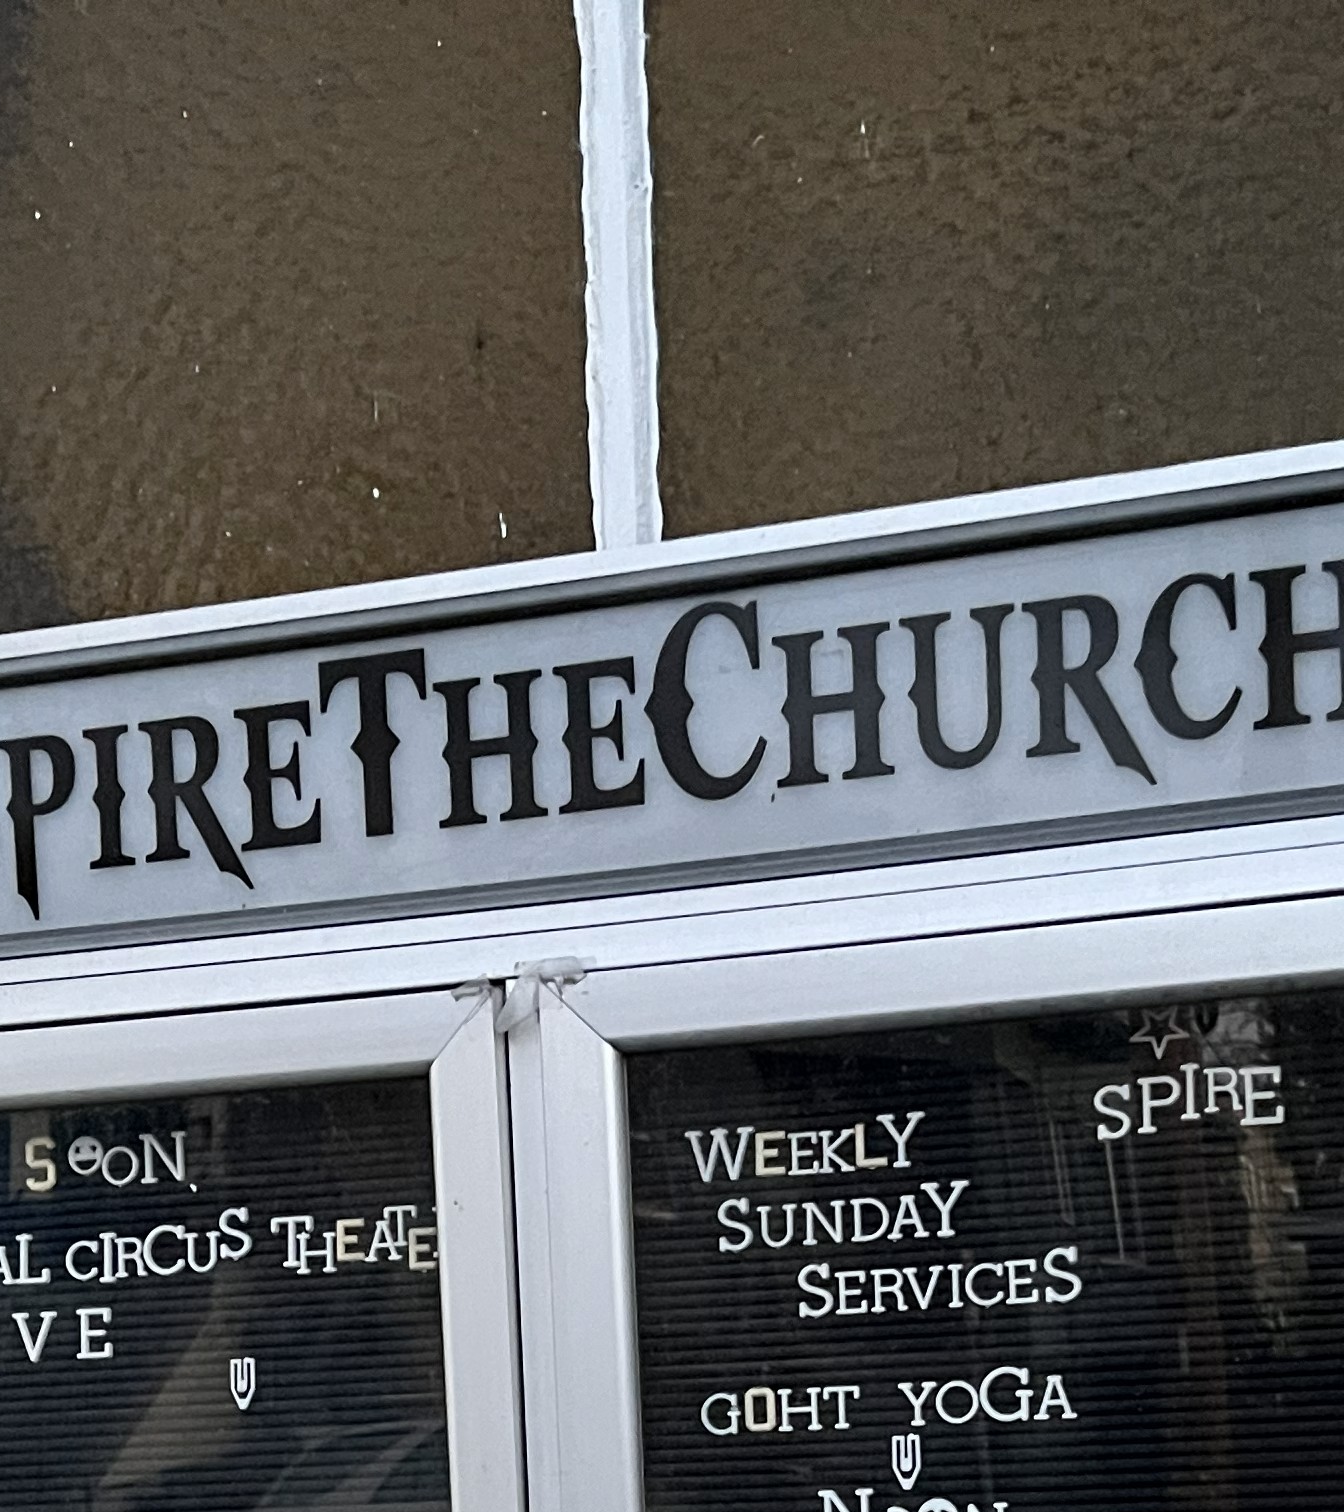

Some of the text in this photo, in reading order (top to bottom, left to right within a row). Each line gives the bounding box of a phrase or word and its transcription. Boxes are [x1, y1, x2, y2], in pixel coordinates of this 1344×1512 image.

[1093, 1062, 1286, 1142] SPIRE
[685, 1111, 926, 1183] WEEKLY
[65, 1207, 252, 1286] CIRCUS
[270, 1204, 439, 1276] THEATE
[717, 1179, 970, 1253] SUNDAY
[797, 1246, 1083, 1319] SERVICES
[700, 1366, 1078, 1435] GOHT YOGA
